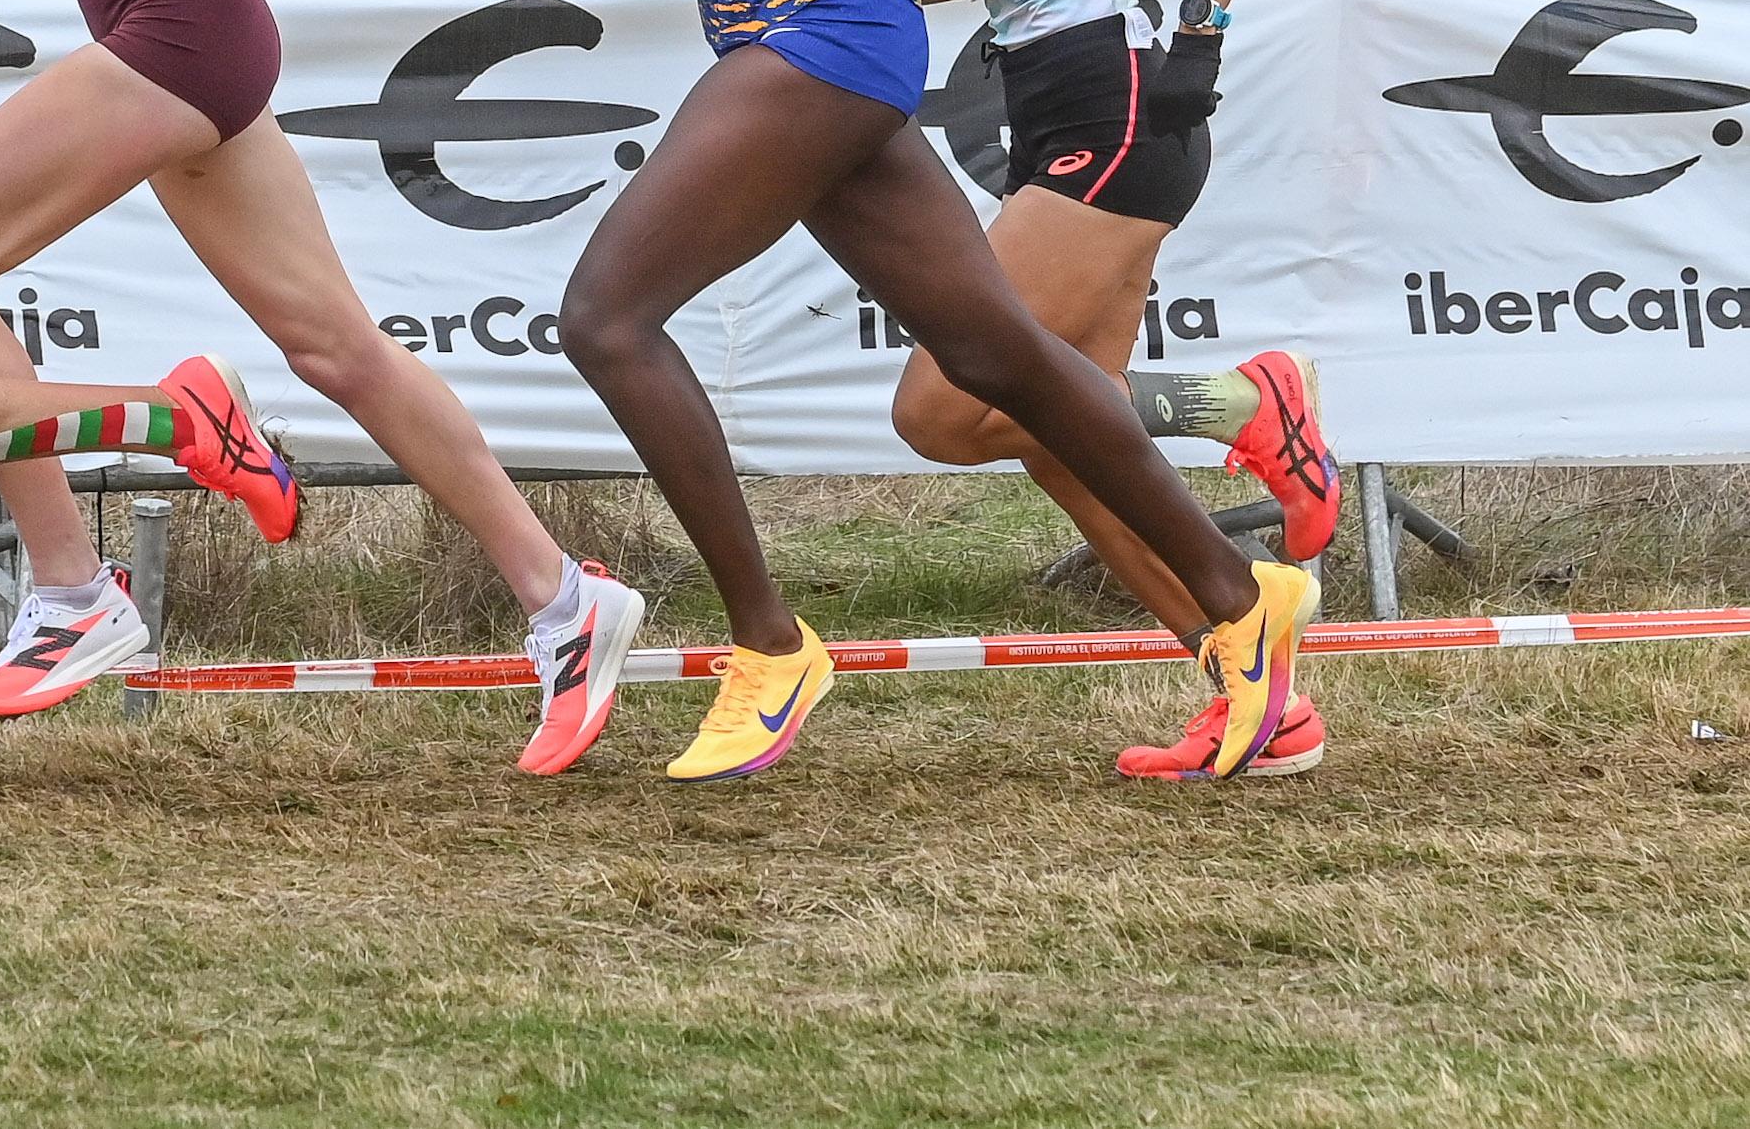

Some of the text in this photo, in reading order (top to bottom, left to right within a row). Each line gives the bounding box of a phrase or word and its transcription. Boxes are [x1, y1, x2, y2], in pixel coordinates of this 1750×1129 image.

[1404, 267, 1750, 348] iberCaja
[1009, 641, 1184, 656] INSTITUTO PARA EL DEPORTE Y JUVENTUD
[833, 652, 886, 663] Y JUVENTUD
